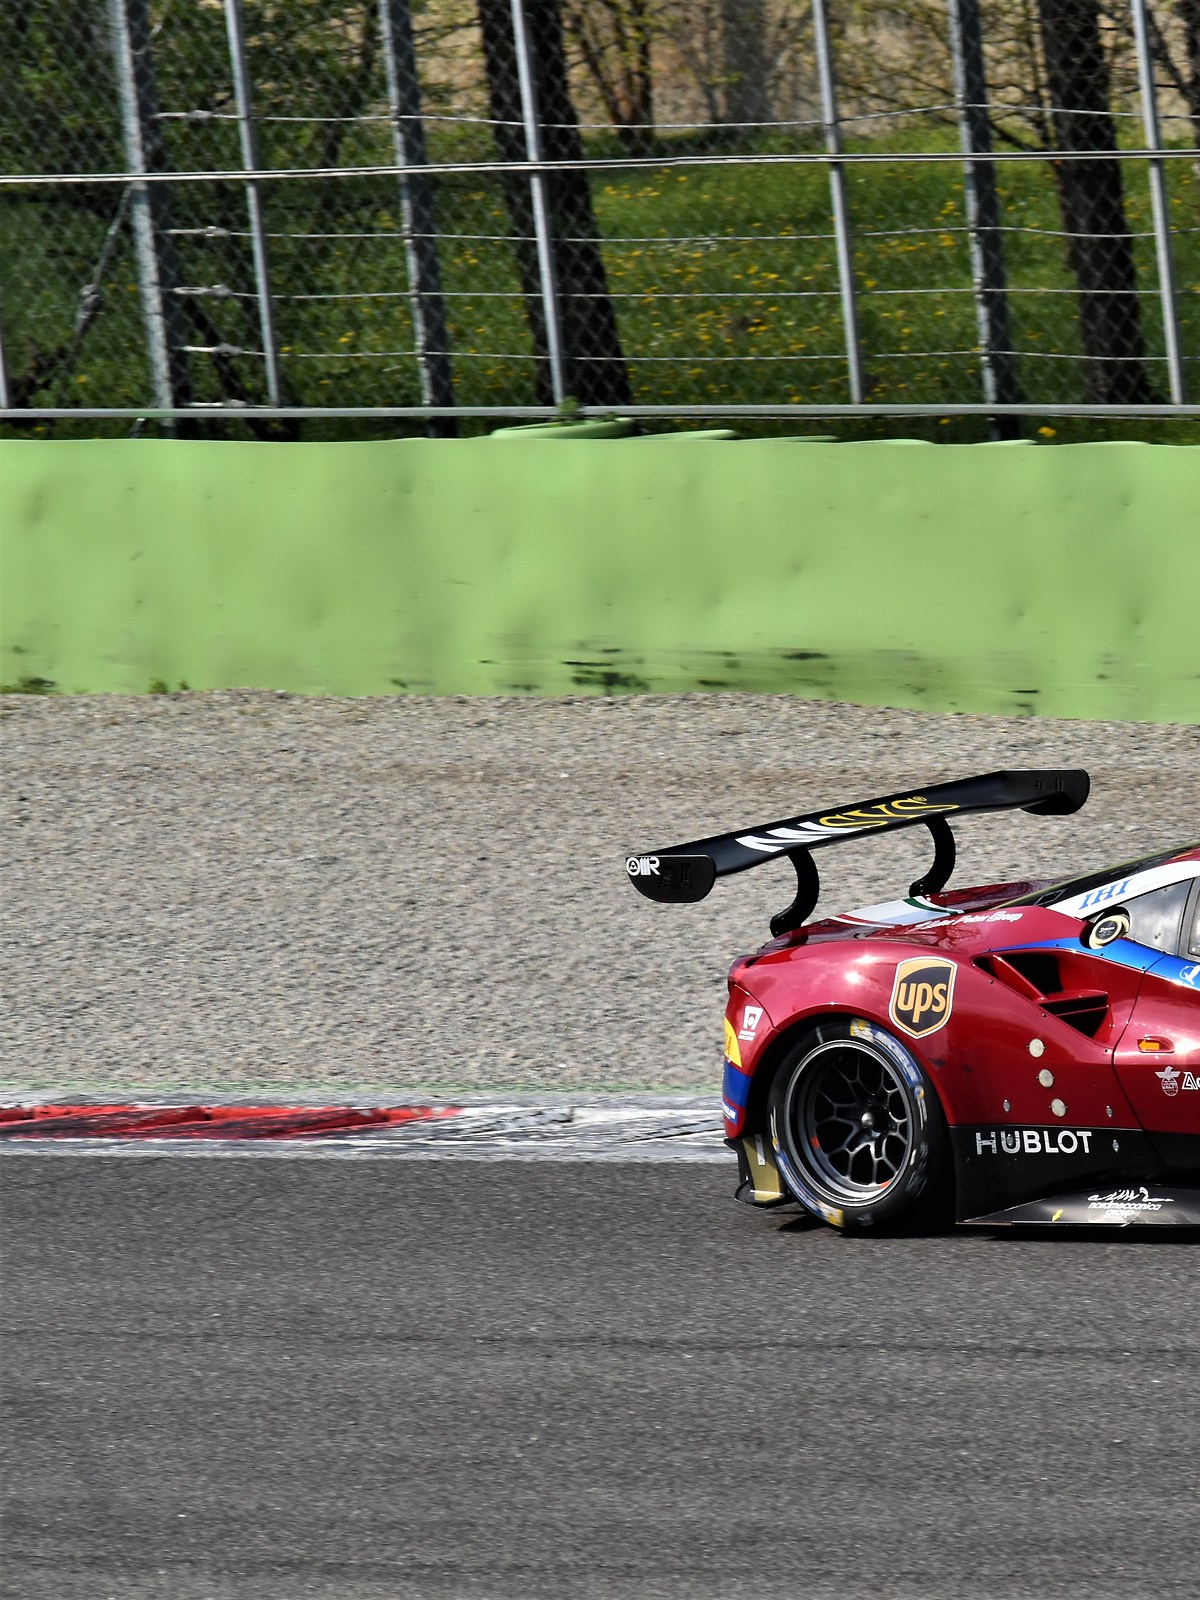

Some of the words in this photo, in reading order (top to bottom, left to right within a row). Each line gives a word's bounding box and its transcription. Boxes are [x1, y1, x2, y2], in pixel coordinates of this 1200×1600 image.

[1079, 879, 1132, 910] IHI
[898, 982, 947, 1024] ups
[975, 1130, 1092, 1155] HUBLOT
